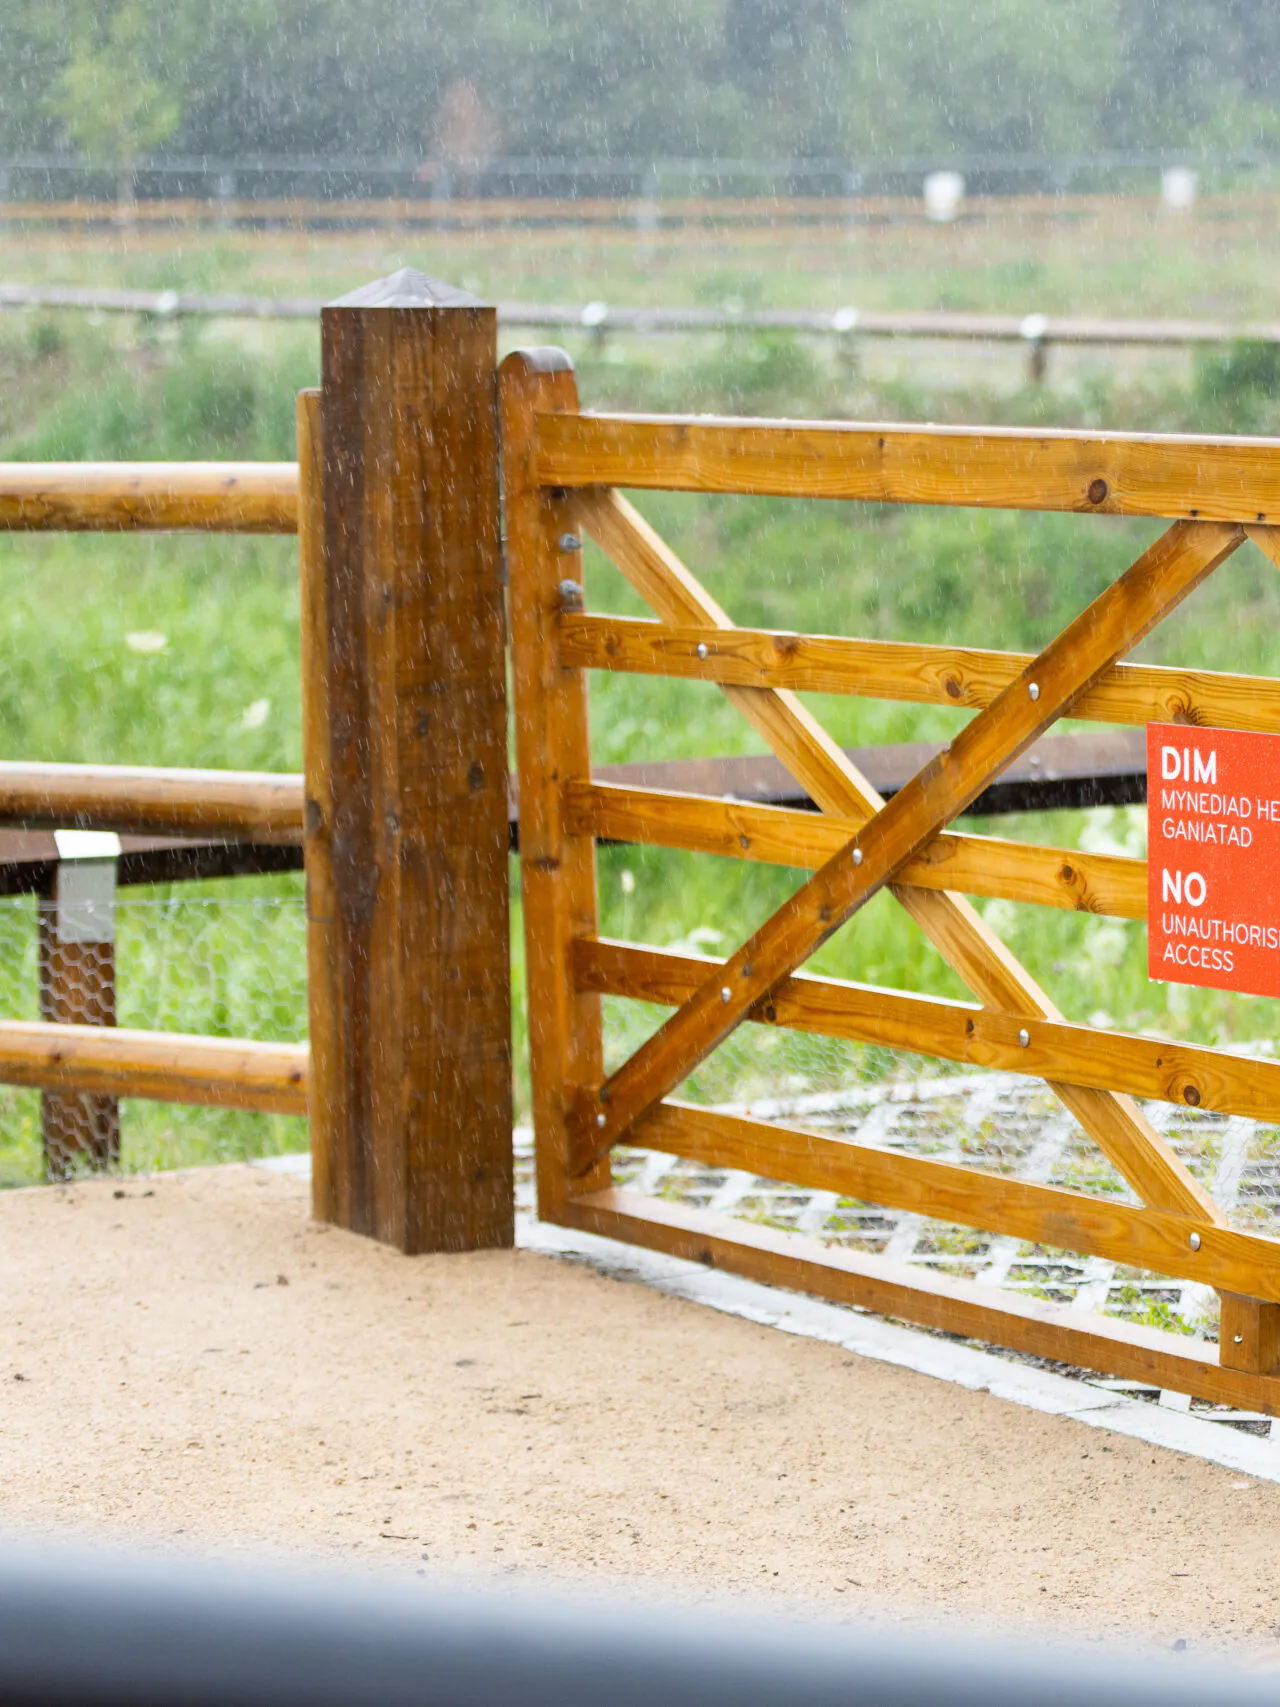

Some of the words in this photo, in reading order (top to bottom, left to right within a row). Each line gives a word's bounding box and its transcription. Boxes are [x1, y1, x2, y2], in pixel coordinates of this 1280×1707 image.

[1161, 746, 1218, 785] DIM
[1161, 789, 1252, 818] MYNEDIAD
[1162, 818, 1253, 848] GANIATAD
[1161, 868, 1207, 907] NO
[1162, 943, 1234, 972] ACCESS
